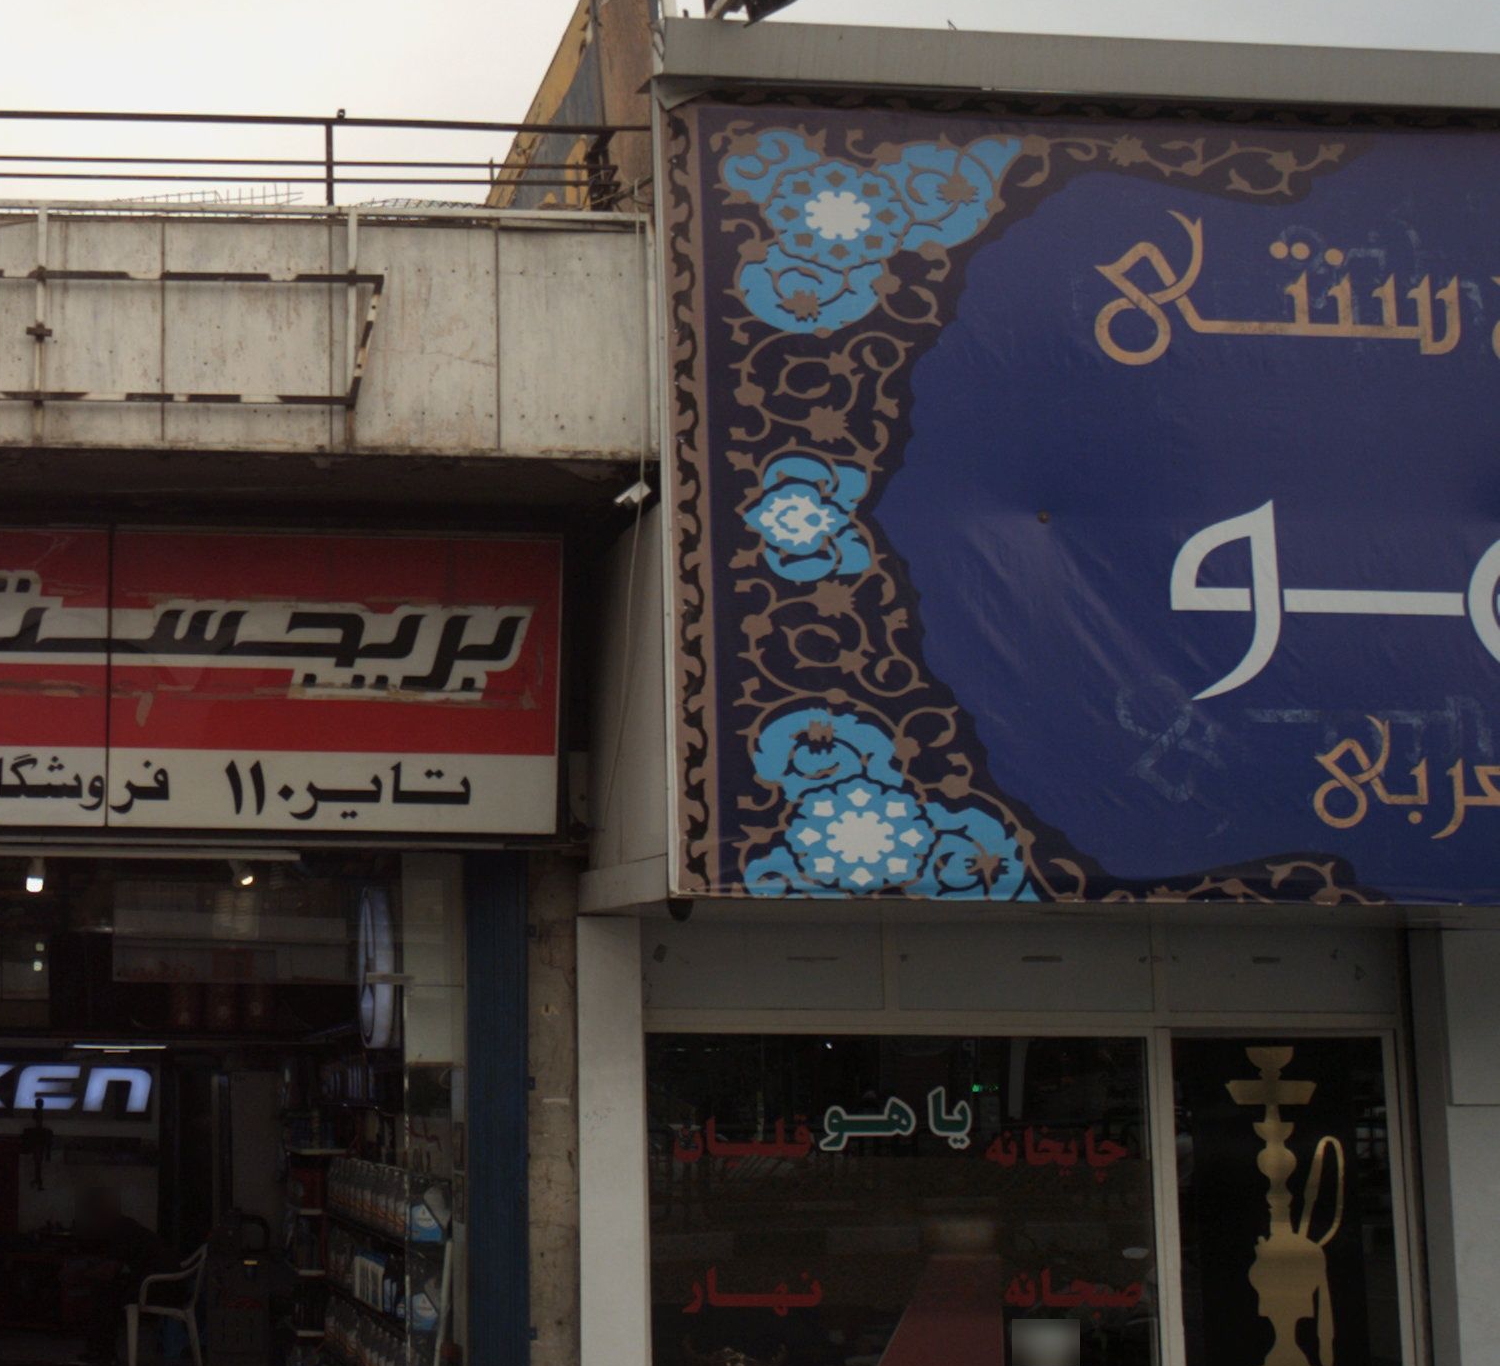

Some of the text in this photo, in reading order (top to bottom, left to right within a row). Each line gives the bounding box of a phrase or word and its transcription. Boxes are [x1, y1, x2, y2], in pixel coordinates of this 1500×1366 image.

[289, 761, 471, 820] تایر
[818, 1095, 917, 1152] هو
[985, 1125, 1130, 1185] چایخانه
[681, 1265, 824, 1317] نهار
